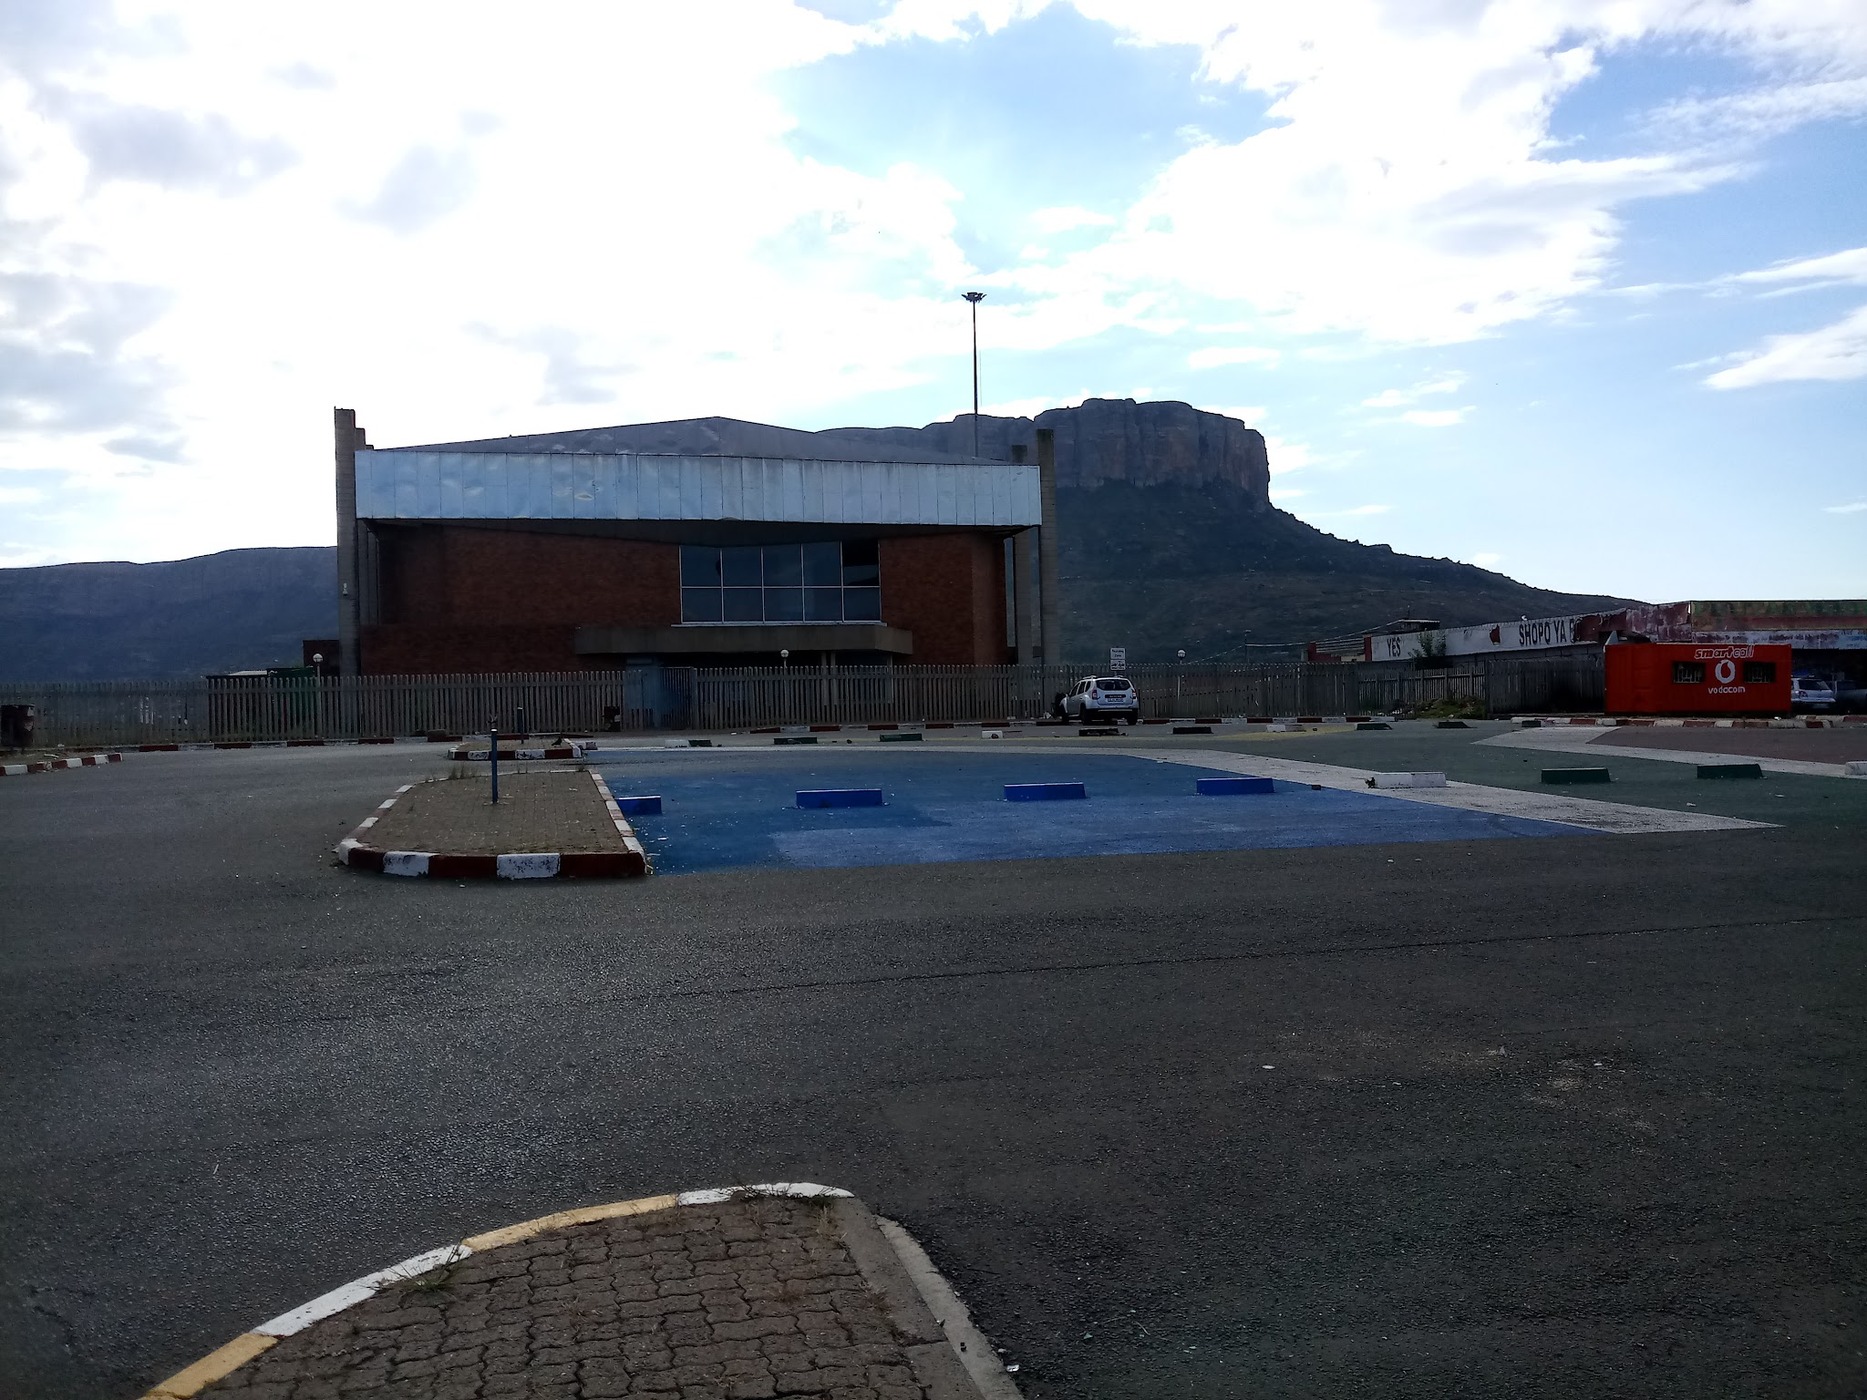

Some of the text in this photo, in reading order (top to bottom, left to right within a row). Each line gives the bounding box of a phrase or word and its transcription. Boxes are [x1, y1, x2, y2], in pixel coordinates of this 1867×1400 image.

[1554, 620, 1567, 643] YA
[1387, 636, 1401, 657] YES
[1695, 644, 1755, 659] smartcall
[1708, 686, 1746, 694] vodacom
